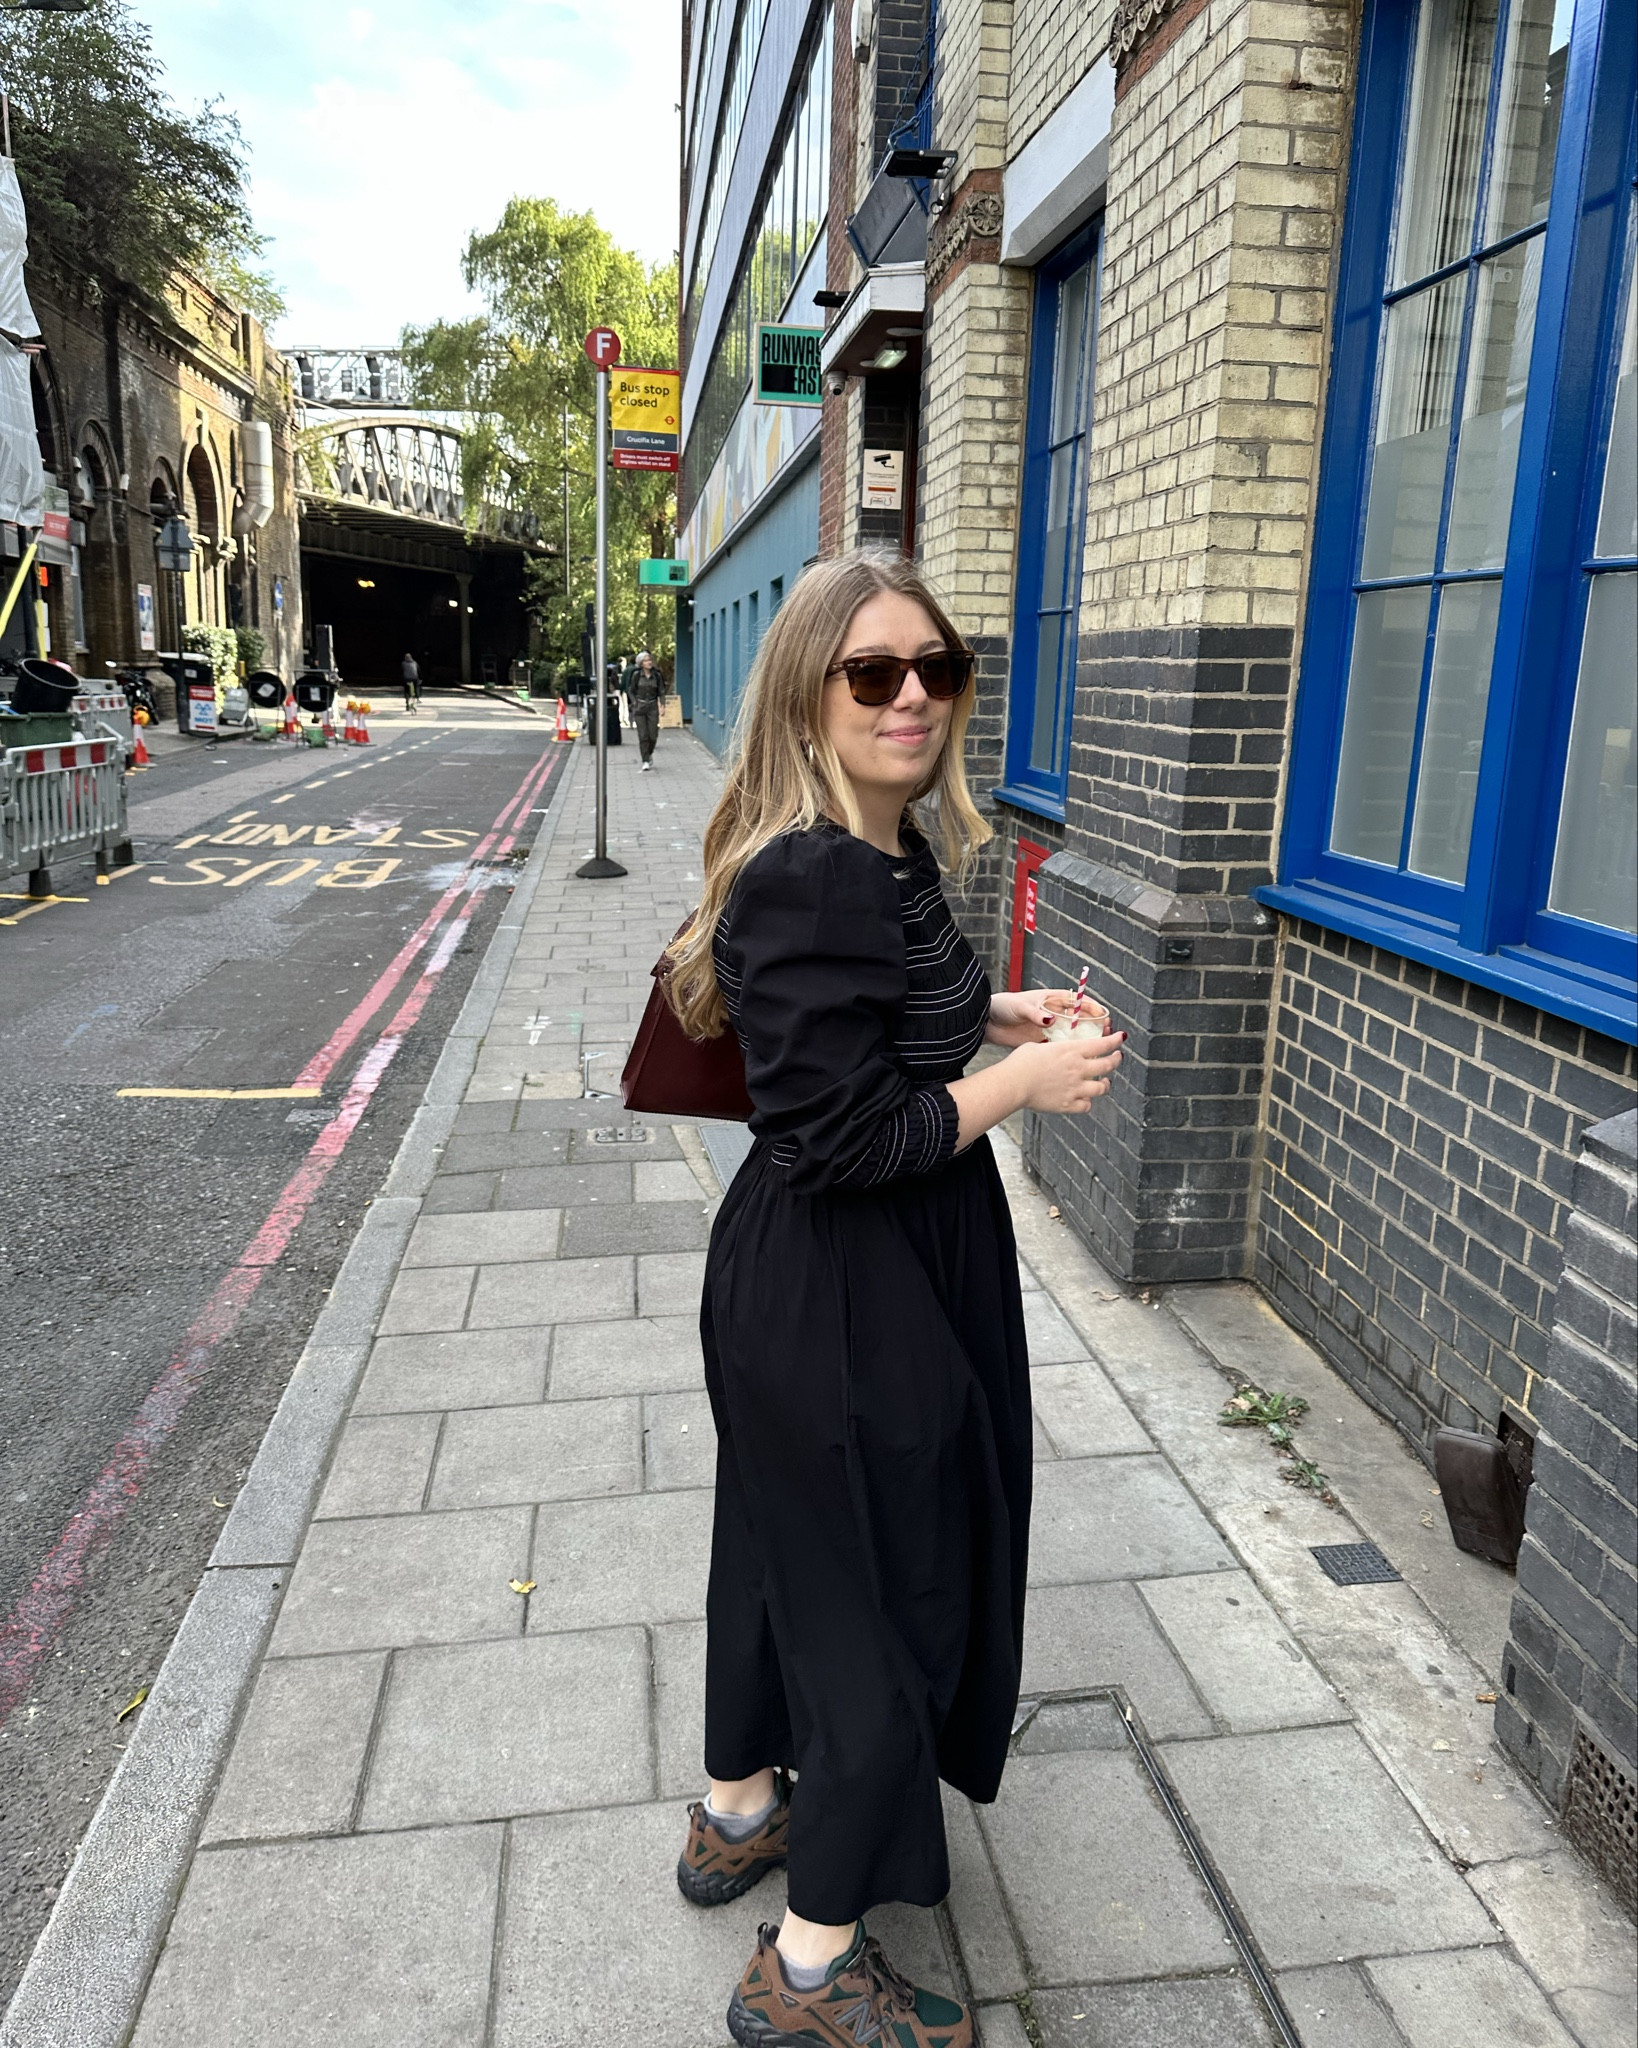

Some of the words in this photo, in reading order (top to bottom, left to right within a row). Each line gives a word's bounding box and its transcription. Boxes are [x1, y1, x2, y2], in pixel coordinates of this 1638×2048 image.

[597, 333, 612, 359] F
[620, 382, 641, 393] Bus
[644, 385, 670, 397] stop
[620, 396, 658, 408] closed
[626, 436, 650, 444] Crucifix
[207, 823, 481, 849] STAND
[148, 857, 403, 889] BUS
